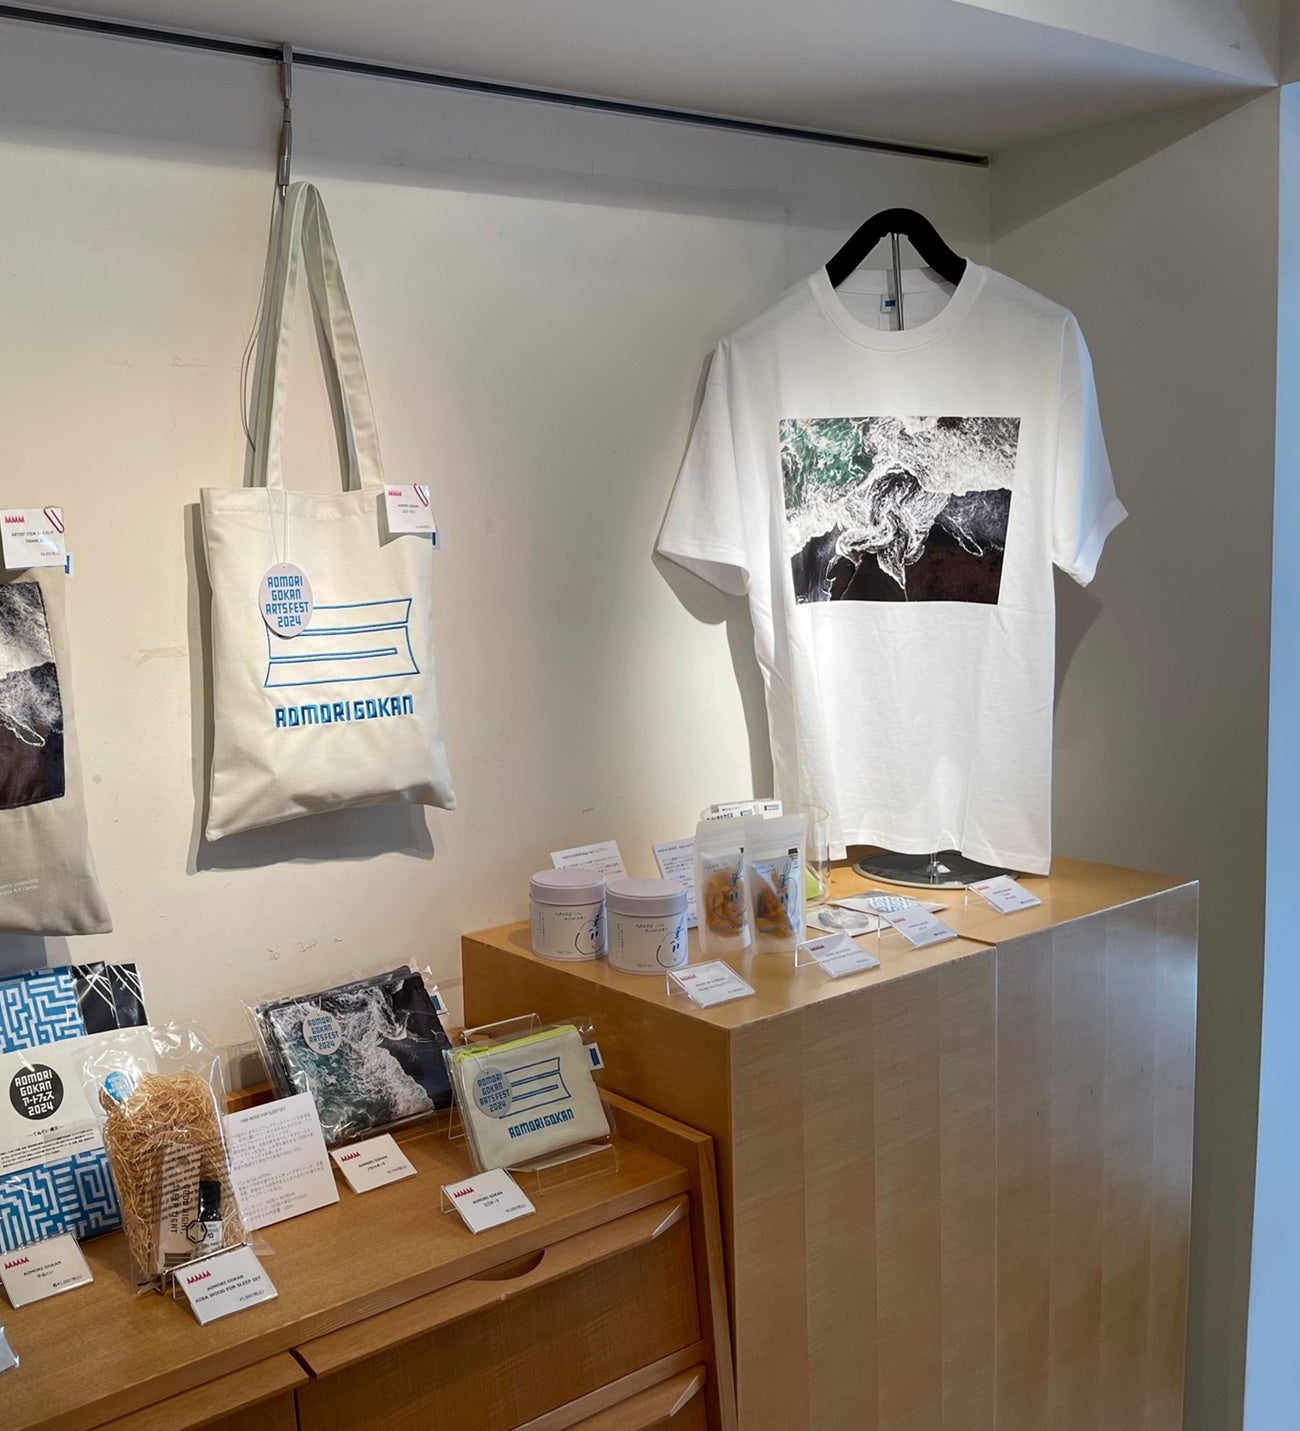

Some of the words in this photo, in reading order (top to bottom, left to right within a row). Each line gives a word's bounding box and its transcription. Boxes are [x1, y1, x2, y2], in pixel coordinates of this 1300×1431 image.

[267, 576, 303, 588] AOMORI
[271, 589, 302, 601] GOKAN
[277, 615, 302, 628] 2024
[275, 701, 351, 728] AOMORI
[353, 694, 414, 720] GOKAN
[307, 1015, 332, 1027] AOMORI
[311, 1024, 333, 1035] GOKAN
[318, 1040, 335, 1050] 2024
[14, 1069, 53, 1087] AOMORI
[477, 1073, 503, 1088] AOMORI
[20, 1080, 53, 1097] GOKAN
[481, 1082, 504, 1096] GOKAN
[22, 1091, 55, 1106] アートフェス
[27, 1101, 54, 1117] 2024
[489, 1101, 506, 1113] 2024
[508, 1118, 545, 1139] AOMORI
[544, 1108, 575, 1127] GOKAN
[23, 1266, 44, 1277] AOMORI
[44, 1260, 62, 1269] GOKAN
[206, 1281, 226, 1291] AOMORI
[227, 1274, 244, 1284] GOKAN
[195, 1295, 209, 1303] HIBA
[209, 1288, 226, 1298] WOOD
[236, 1279, 252, 1288] SLEEP
